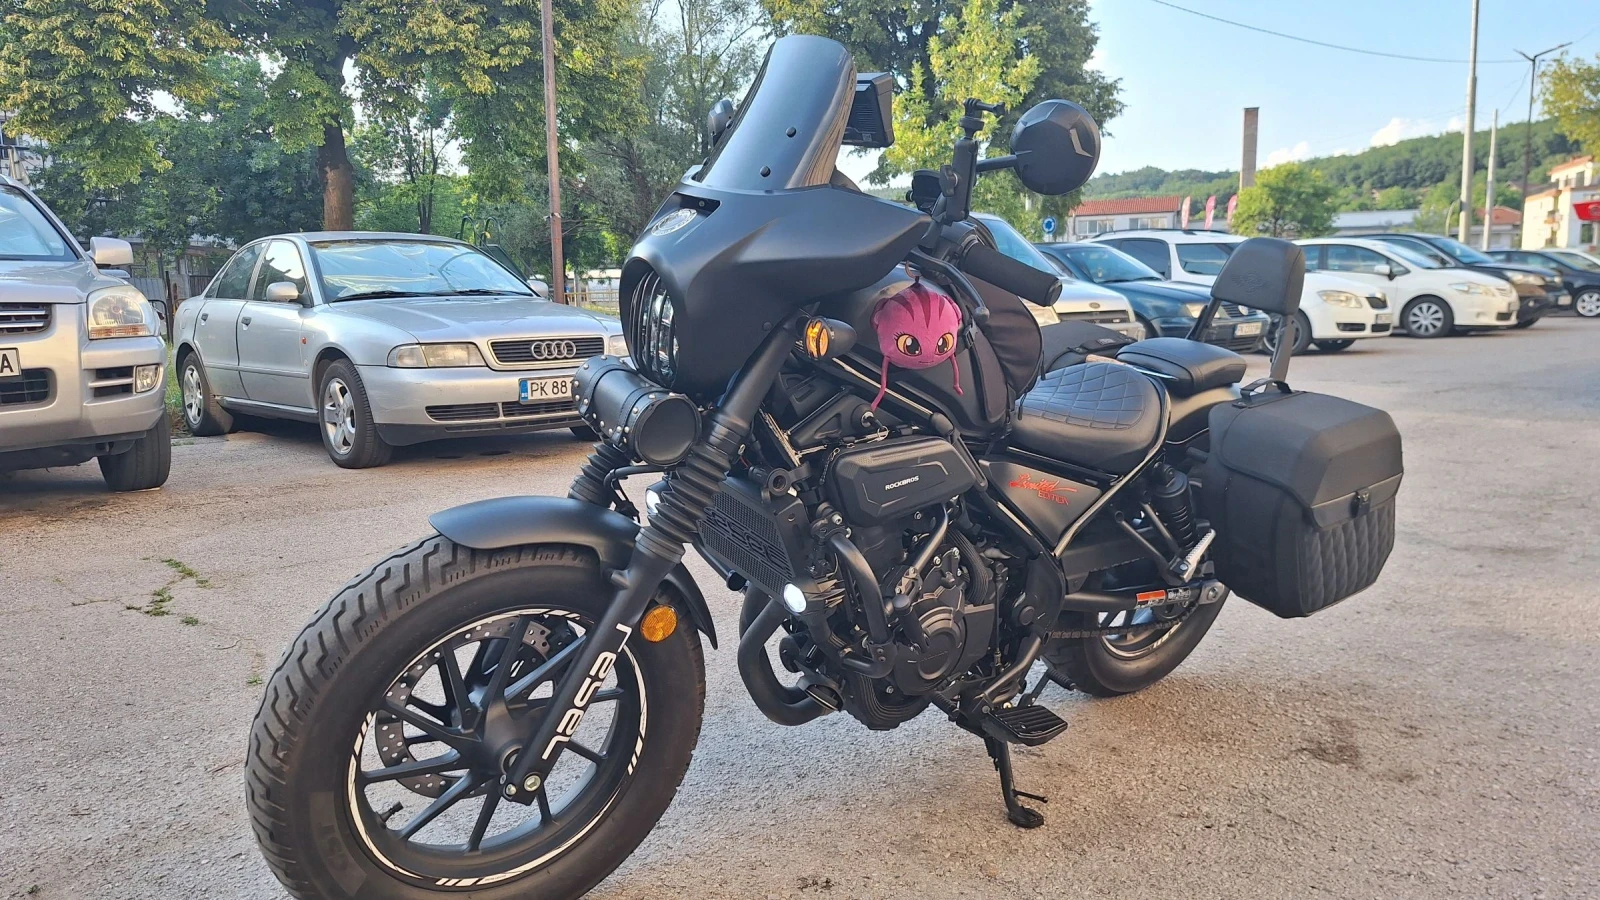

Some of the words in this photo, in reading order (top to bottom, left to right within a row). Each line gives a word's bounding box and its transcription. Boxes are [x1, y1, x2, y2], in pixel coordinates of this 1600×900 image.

[530, 381, 548, 397] PK
[552, 380, 572, 395] 88
[885, 475, 919, 490] ROCKBROS
[1009, 473, 1077, 492] Limited
[542, 623, 632, 760] rebel
